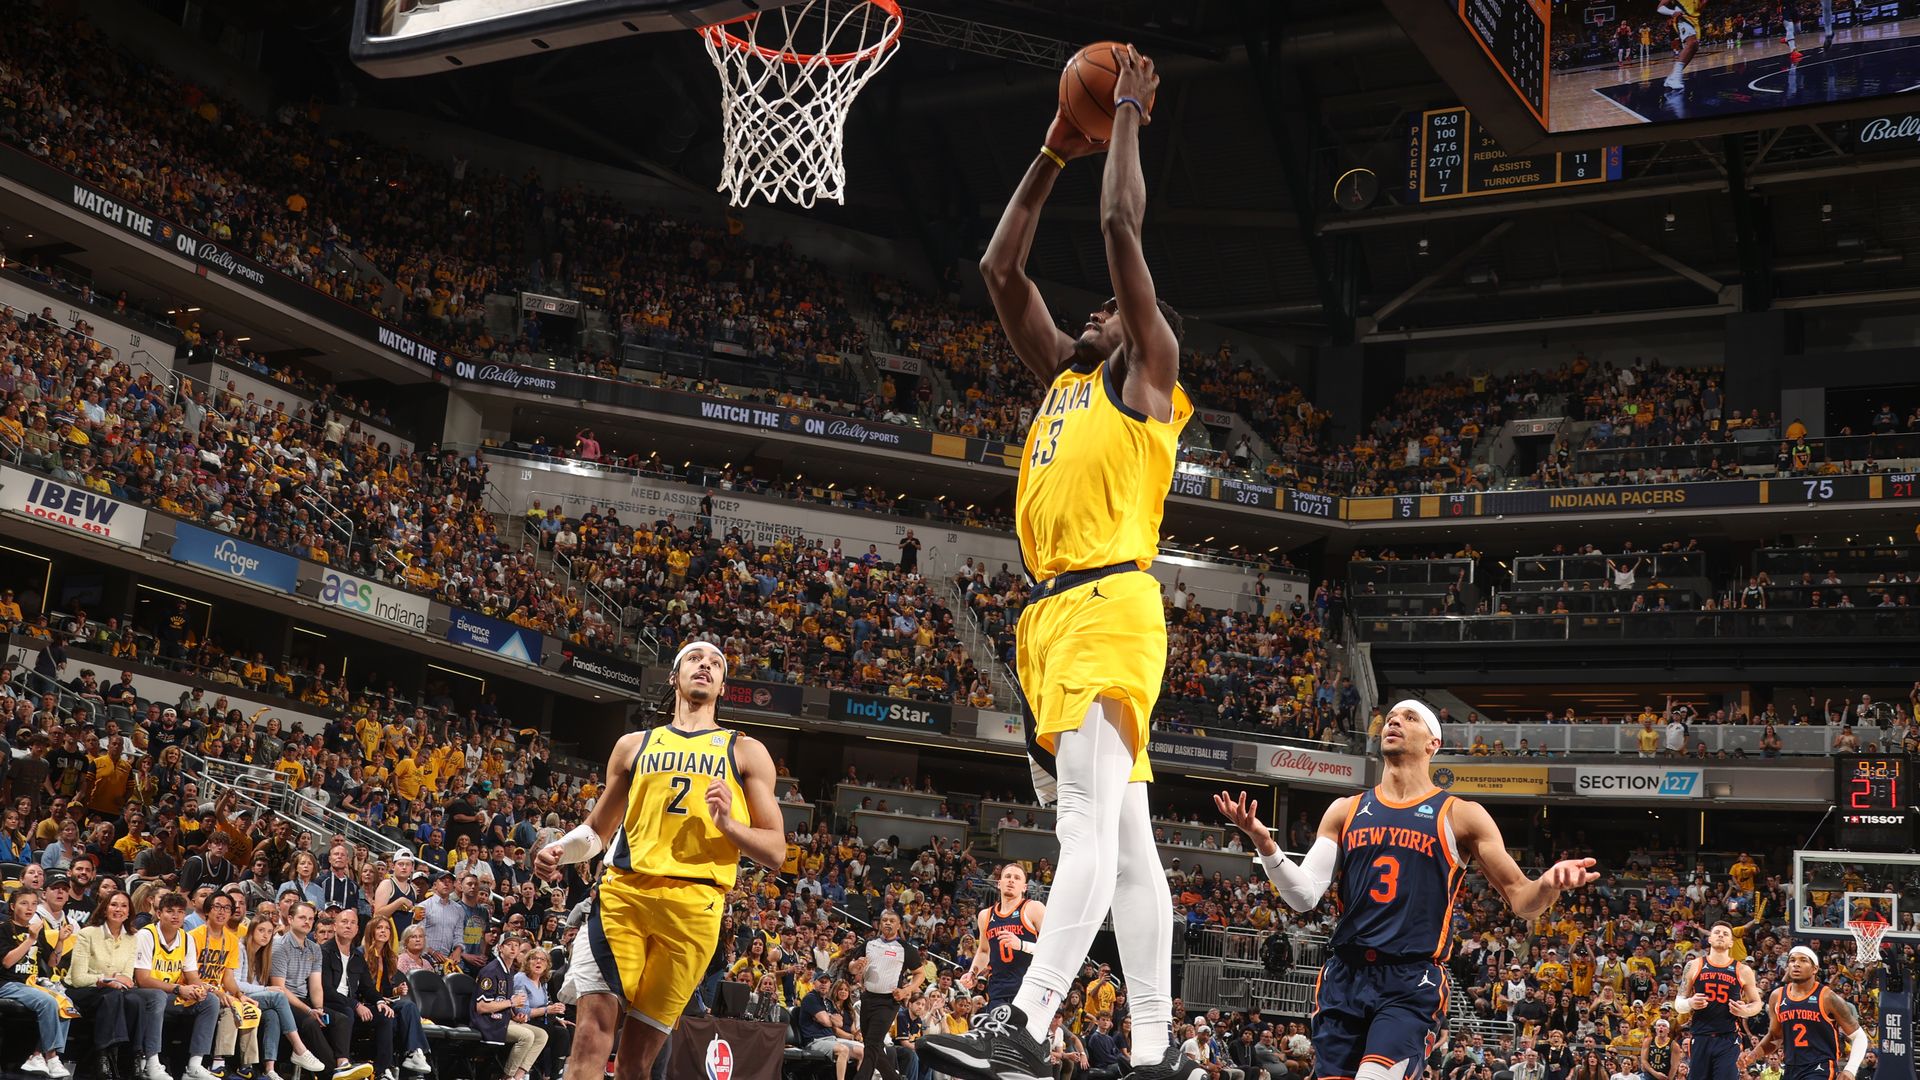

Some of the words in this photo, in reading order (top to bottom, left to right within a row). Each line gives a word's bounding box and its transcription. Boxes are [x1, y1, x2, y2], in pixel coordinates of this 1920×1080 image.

[1433, 115, 1458, 127] 62.0
[1860, 115, 1920, 143] Ball
[1436, 129, 1456, 140] 100
[1433, 141, 1457, 153] 47.6
[1409, 126, 1420, 190] PACERS
[1429, 156, 1444, 168] 27
[1446, 154, 1460, 167] (7)
[1574, 153, 1588, 164] 11
[1492, 160, 1532, 173] ASSISTS
[1576, 168, 1585, 178] 8
[1438, 170, 1452, 180] 17
[1484, 173, 1540, 188] TURNOVERS
[1440, 183, 1448, 193] 7
[73, 185, 124, 223] WATCH
[126, 207, 154, 236] THE
[176, 234, 197, 257] ON
[199, 243, 237, 275] Bally
[236, 264, 265, 286] SPORTS
[68, 310, 80, 323] 117
[378, 326, 416, 355] WATCH
[417, 343, 437, 366] THE
[456, 362, 476, 380] ON
[478, 364, 524, 389] Bally
[523, 376, 557, 390] SPORTS
[701, 402, 750, 425] WATCH
[752, 410, 780, 428] THE
[804, 418, 825, 435] ON
[828, 420, 870, 443] Bally
[869, 430, 900, 444] SPORTS
[1182, 474, 1206, 484] GOALS
[1890, 474, 1916, 483] SHOT
[1223, 480, 1242, 490] FREE
[1243, 482, 1273, 494] THROWS
[1802, 480, 1834, 500] 75
[1893, 484, 1912, 497] 21
[27, 478, 120, 524] IBEW
[631, 487, 661, 500] NEED
[662, 492, 740, 512] ASSISTNCE?
[1236, 490, 1259, 505] 3/3
[1291, 490, 1320, 502] 3-POINT
[1320, 494, 1332, 504] FG
[1550, 493, 1617, 508] INDIANA
[1622, 489, 1686, 505] PACERS
[1293, 499, 1329, 516] 10/21
[1402, 505, 1411, 518] 5
[1452, 502, 1462, 515] 0
[24, 504, 76, 528] LOCAL
[82, 521, 112, 538] 481
[214, 540, 259, 576] Kroger
[322, 574, 373, 614] aes
[374, 598, 425, 631] Indiana
[456, 616, 490, 637] Elevance
[471, 632, 490, 645] Health
[572, 655, 602, 674] Fanatics
[602, 664, 641, 687] Sportsbook
[1154, 742, 1174, 754] GROW
[1174, 744, 1212, 759] BASKETBALL
[1212, 750, 1228, 760] HERE
[640, 751, 727, 780] INDIANA
[1270, 749, 1320, 777] Bally
[1318, 762, 1352, 777] SPORTS
[1858, 761, 1900, 777] 9:21
[1455, 776, 1544, 785] PACERSFOUNDATION.org
[1579, 774, 1660, 790] SECTION
[1660, 776, 1690, 791] 127
[666, 776, 692, 816] 2
[1851, 778, 1897, 808] 21
[1860, 816, 1904, 824] TISSOT
[1347, 826, 1388, 853] NEW
[1388, 826, 1436, 858] YORK
[1370, 856, 1400, 904] 3
[1000, 938, 1014, 963] 0
[1700, 972, 1718, 984] NEW
[1718, 972, 1737, 985] YORK
[1704, 982, 1730, 1004] 55
[1778, 1010, 1798, 1023] NEW
[1798, 1010, 1821, 1022] YORK
[1886, 1014, 1902, 1026] GET
[1792, 1023, 1808, 1047] 2
[1886, 1026, 1902, 1040] THE
[1890, 1040, 1906, 1056] App
